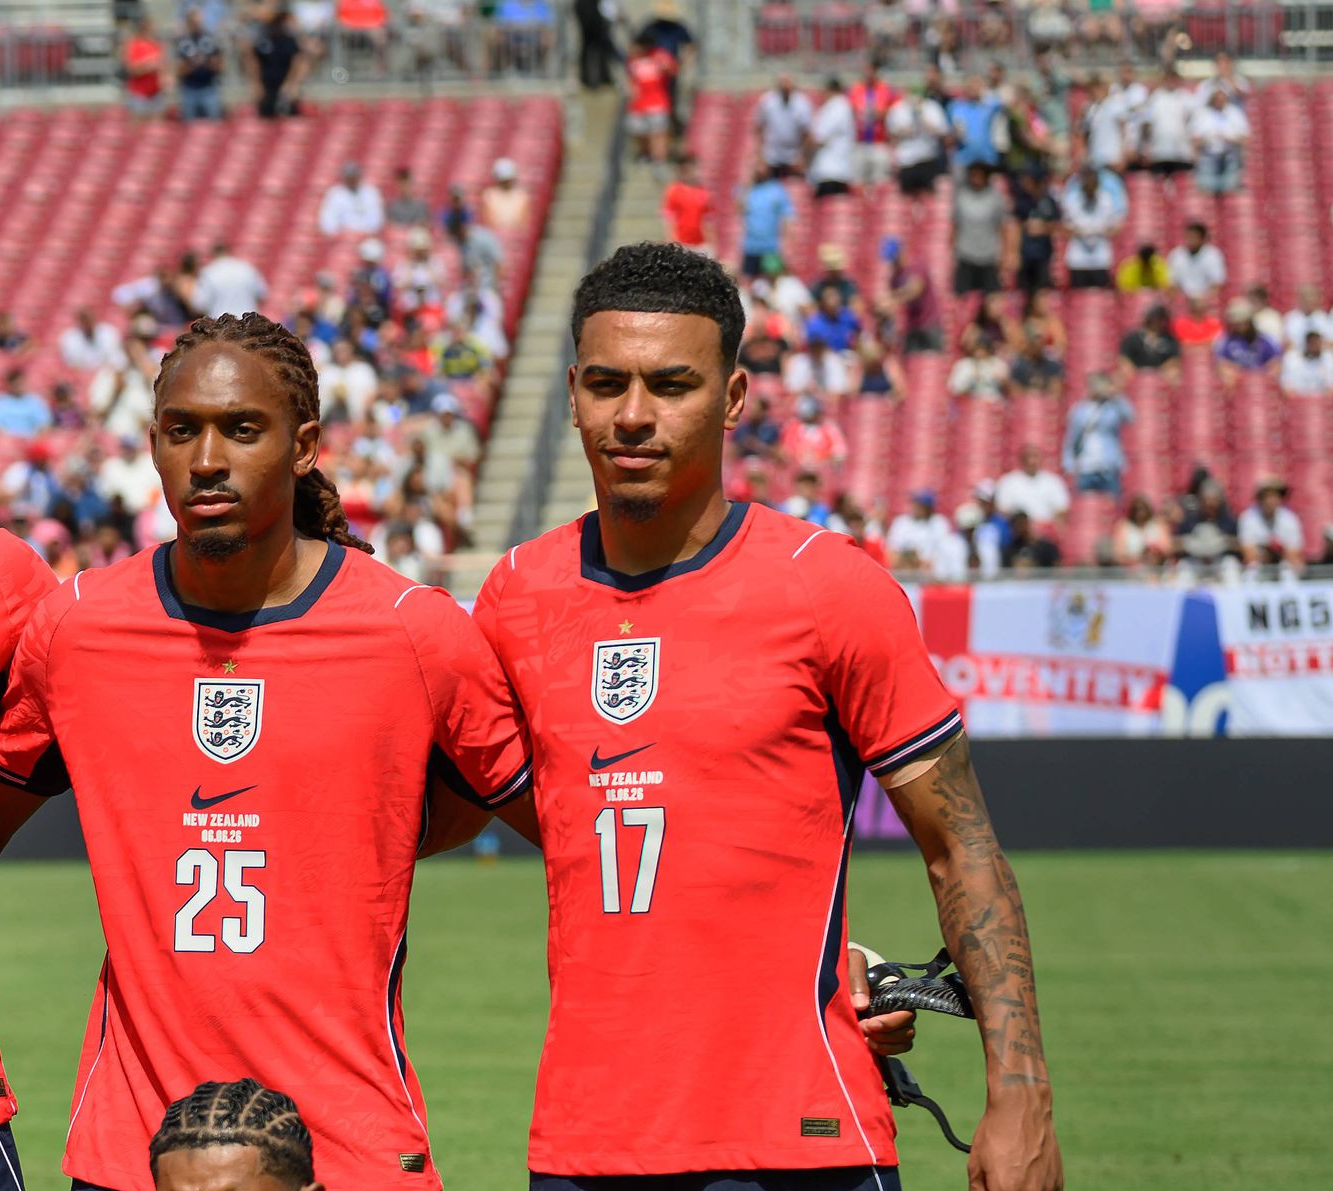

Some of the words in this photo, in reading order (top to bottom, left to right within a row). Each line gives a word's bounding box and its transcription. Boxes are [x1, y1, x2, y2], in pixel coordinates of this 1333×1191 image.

[931, 655, 1160, 710] OVENTRY
[588, 772, 610, 788] NEW
[611, 771, 664, 786] ZEALAND
[182, 812, 208, 828] NEW
[210, 813, 260, 828] ZEALAND
[201, 829, 242, 843] 06.06.26
[594, 806, 666, 914] 17
[174, 847, 267, 954] 25
